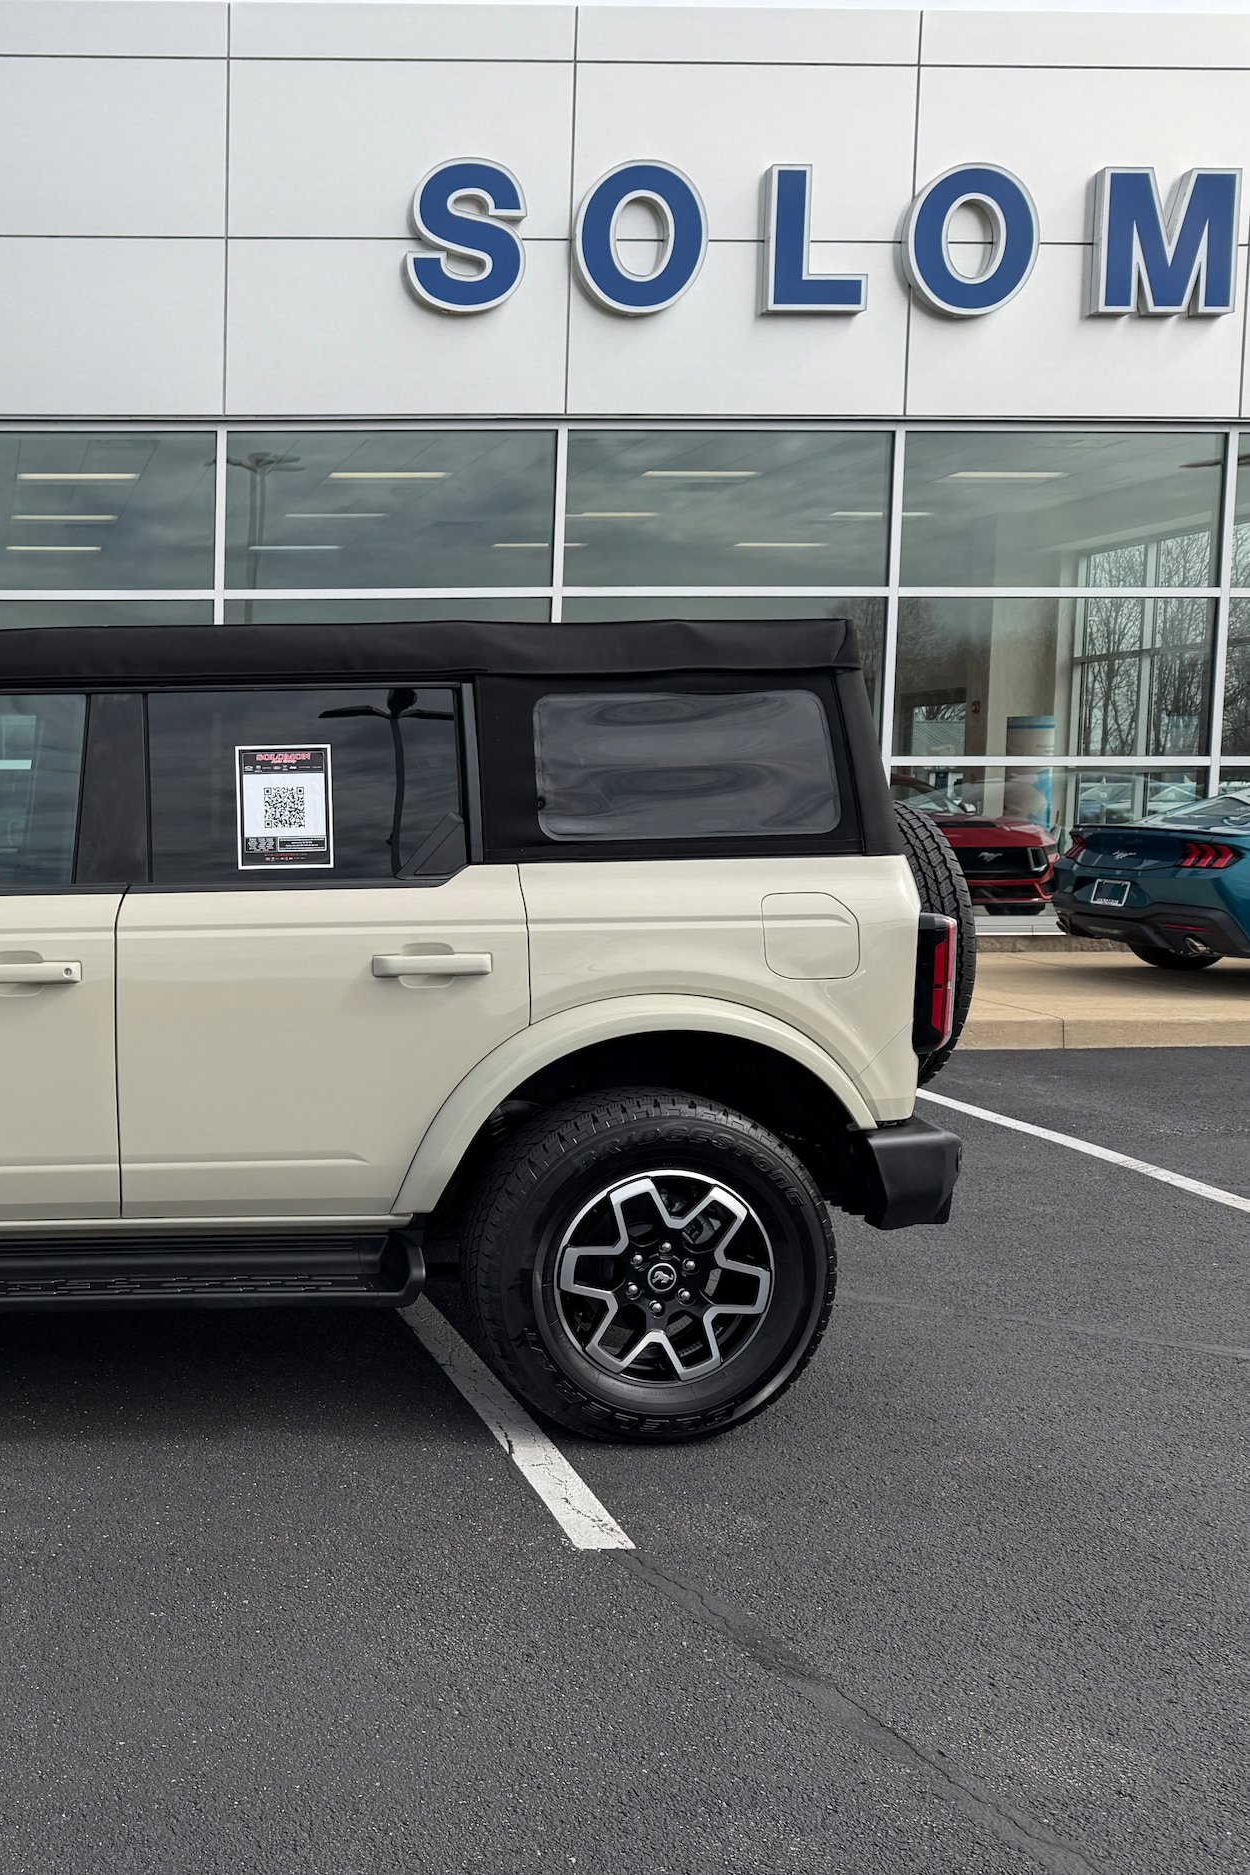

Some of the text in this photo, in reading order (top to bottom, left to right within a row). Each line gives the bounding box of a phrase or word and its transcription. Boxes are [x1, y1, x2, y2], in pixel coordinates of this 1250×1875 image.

[403, 156, 1244, 316] SOLOM
[256, 753, 311, 761] SOLOMON
[573, 1125, 807, 1208] BRIDGESTONE
